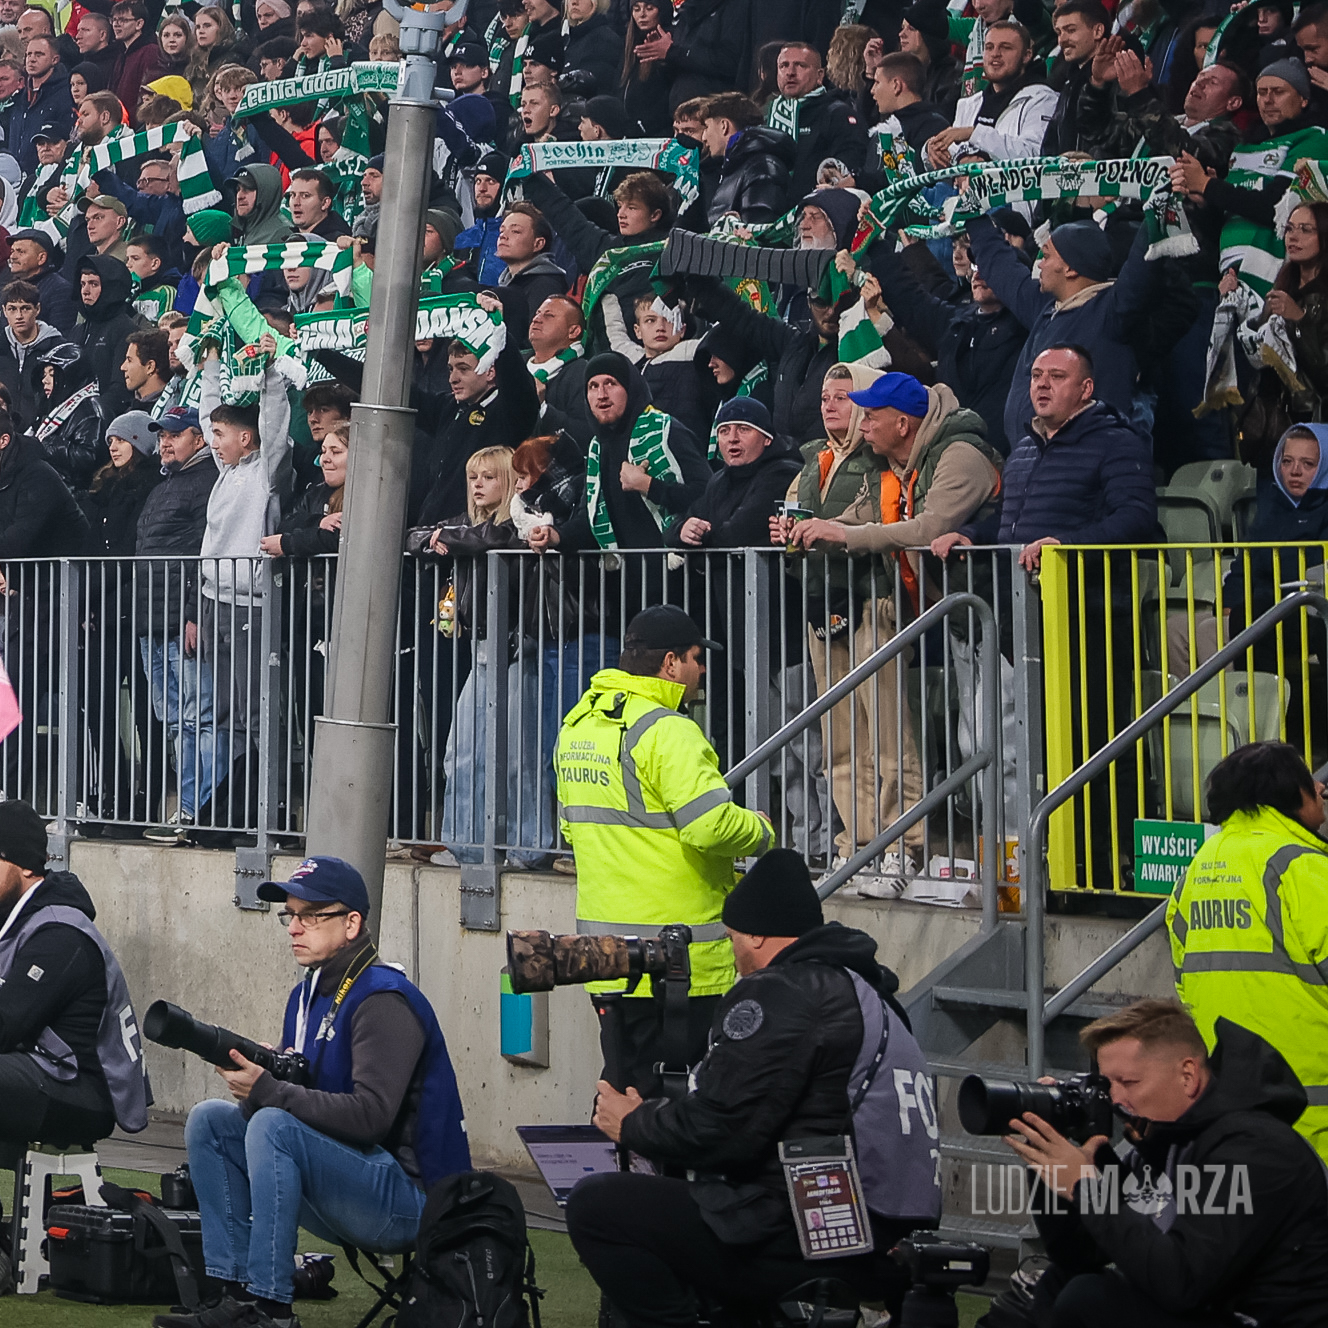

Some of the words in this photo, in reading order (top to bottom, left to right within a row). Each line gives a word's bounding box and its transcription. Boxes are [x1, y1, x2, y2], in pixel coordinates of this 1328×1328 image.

[542, 142, 606, 160] Lechia
[973, 166, 1043, 199] WŁADCY
[560, 752, 611, 765] NFORMACYJNA
[561, 767, 610, 787] TAURUS
[1142, 833, 1198, 858] WYJŚCIE
[335, 976, 354, 1006] Nikon
